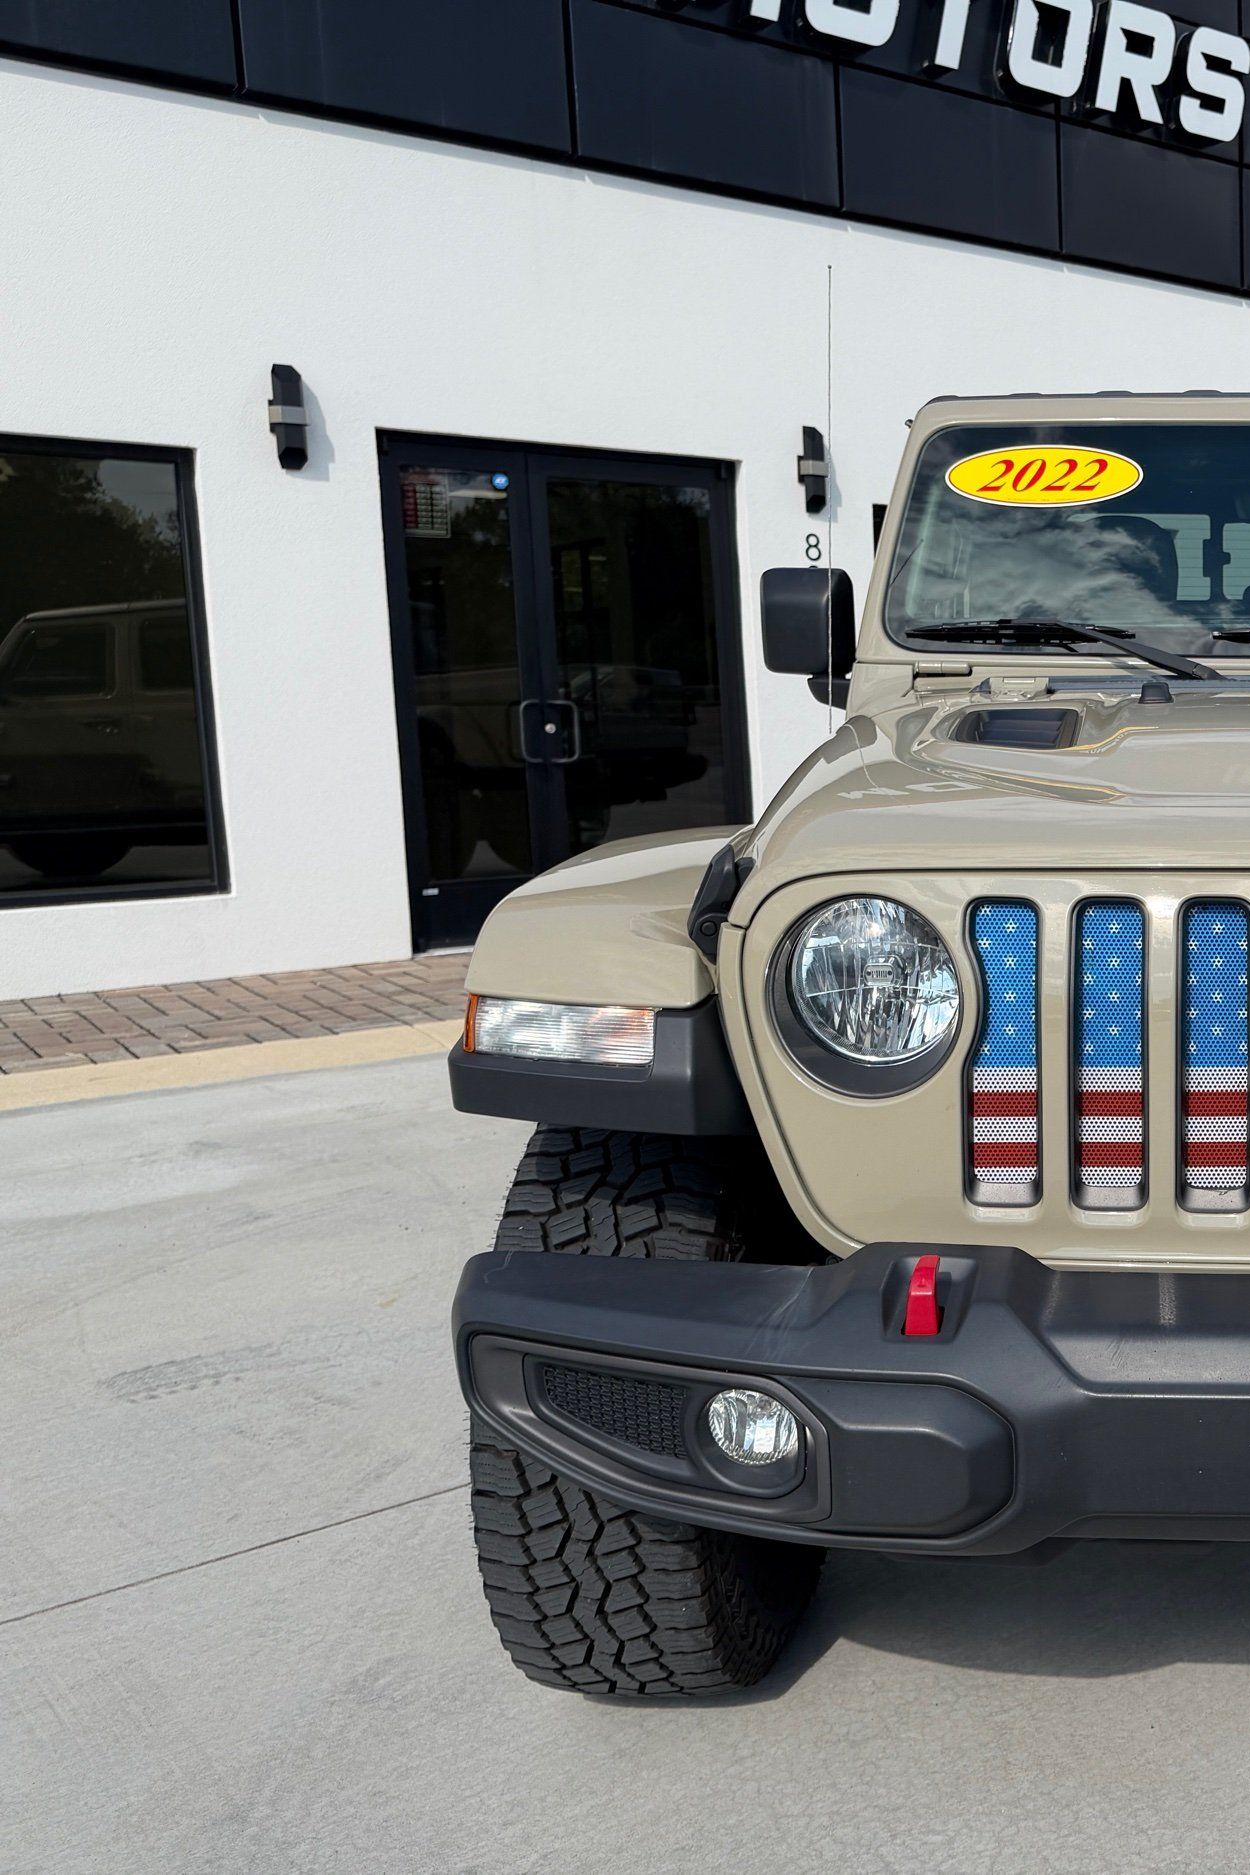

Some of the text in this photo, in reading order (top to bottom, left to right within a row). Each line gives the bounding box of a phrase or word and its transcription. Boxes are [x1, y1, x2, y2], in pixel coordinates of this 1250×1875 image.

[750, 0, 1250, 142] ORS
[976, 458, 1108, 492] 2022
[805, 533, 822, 568] 8
